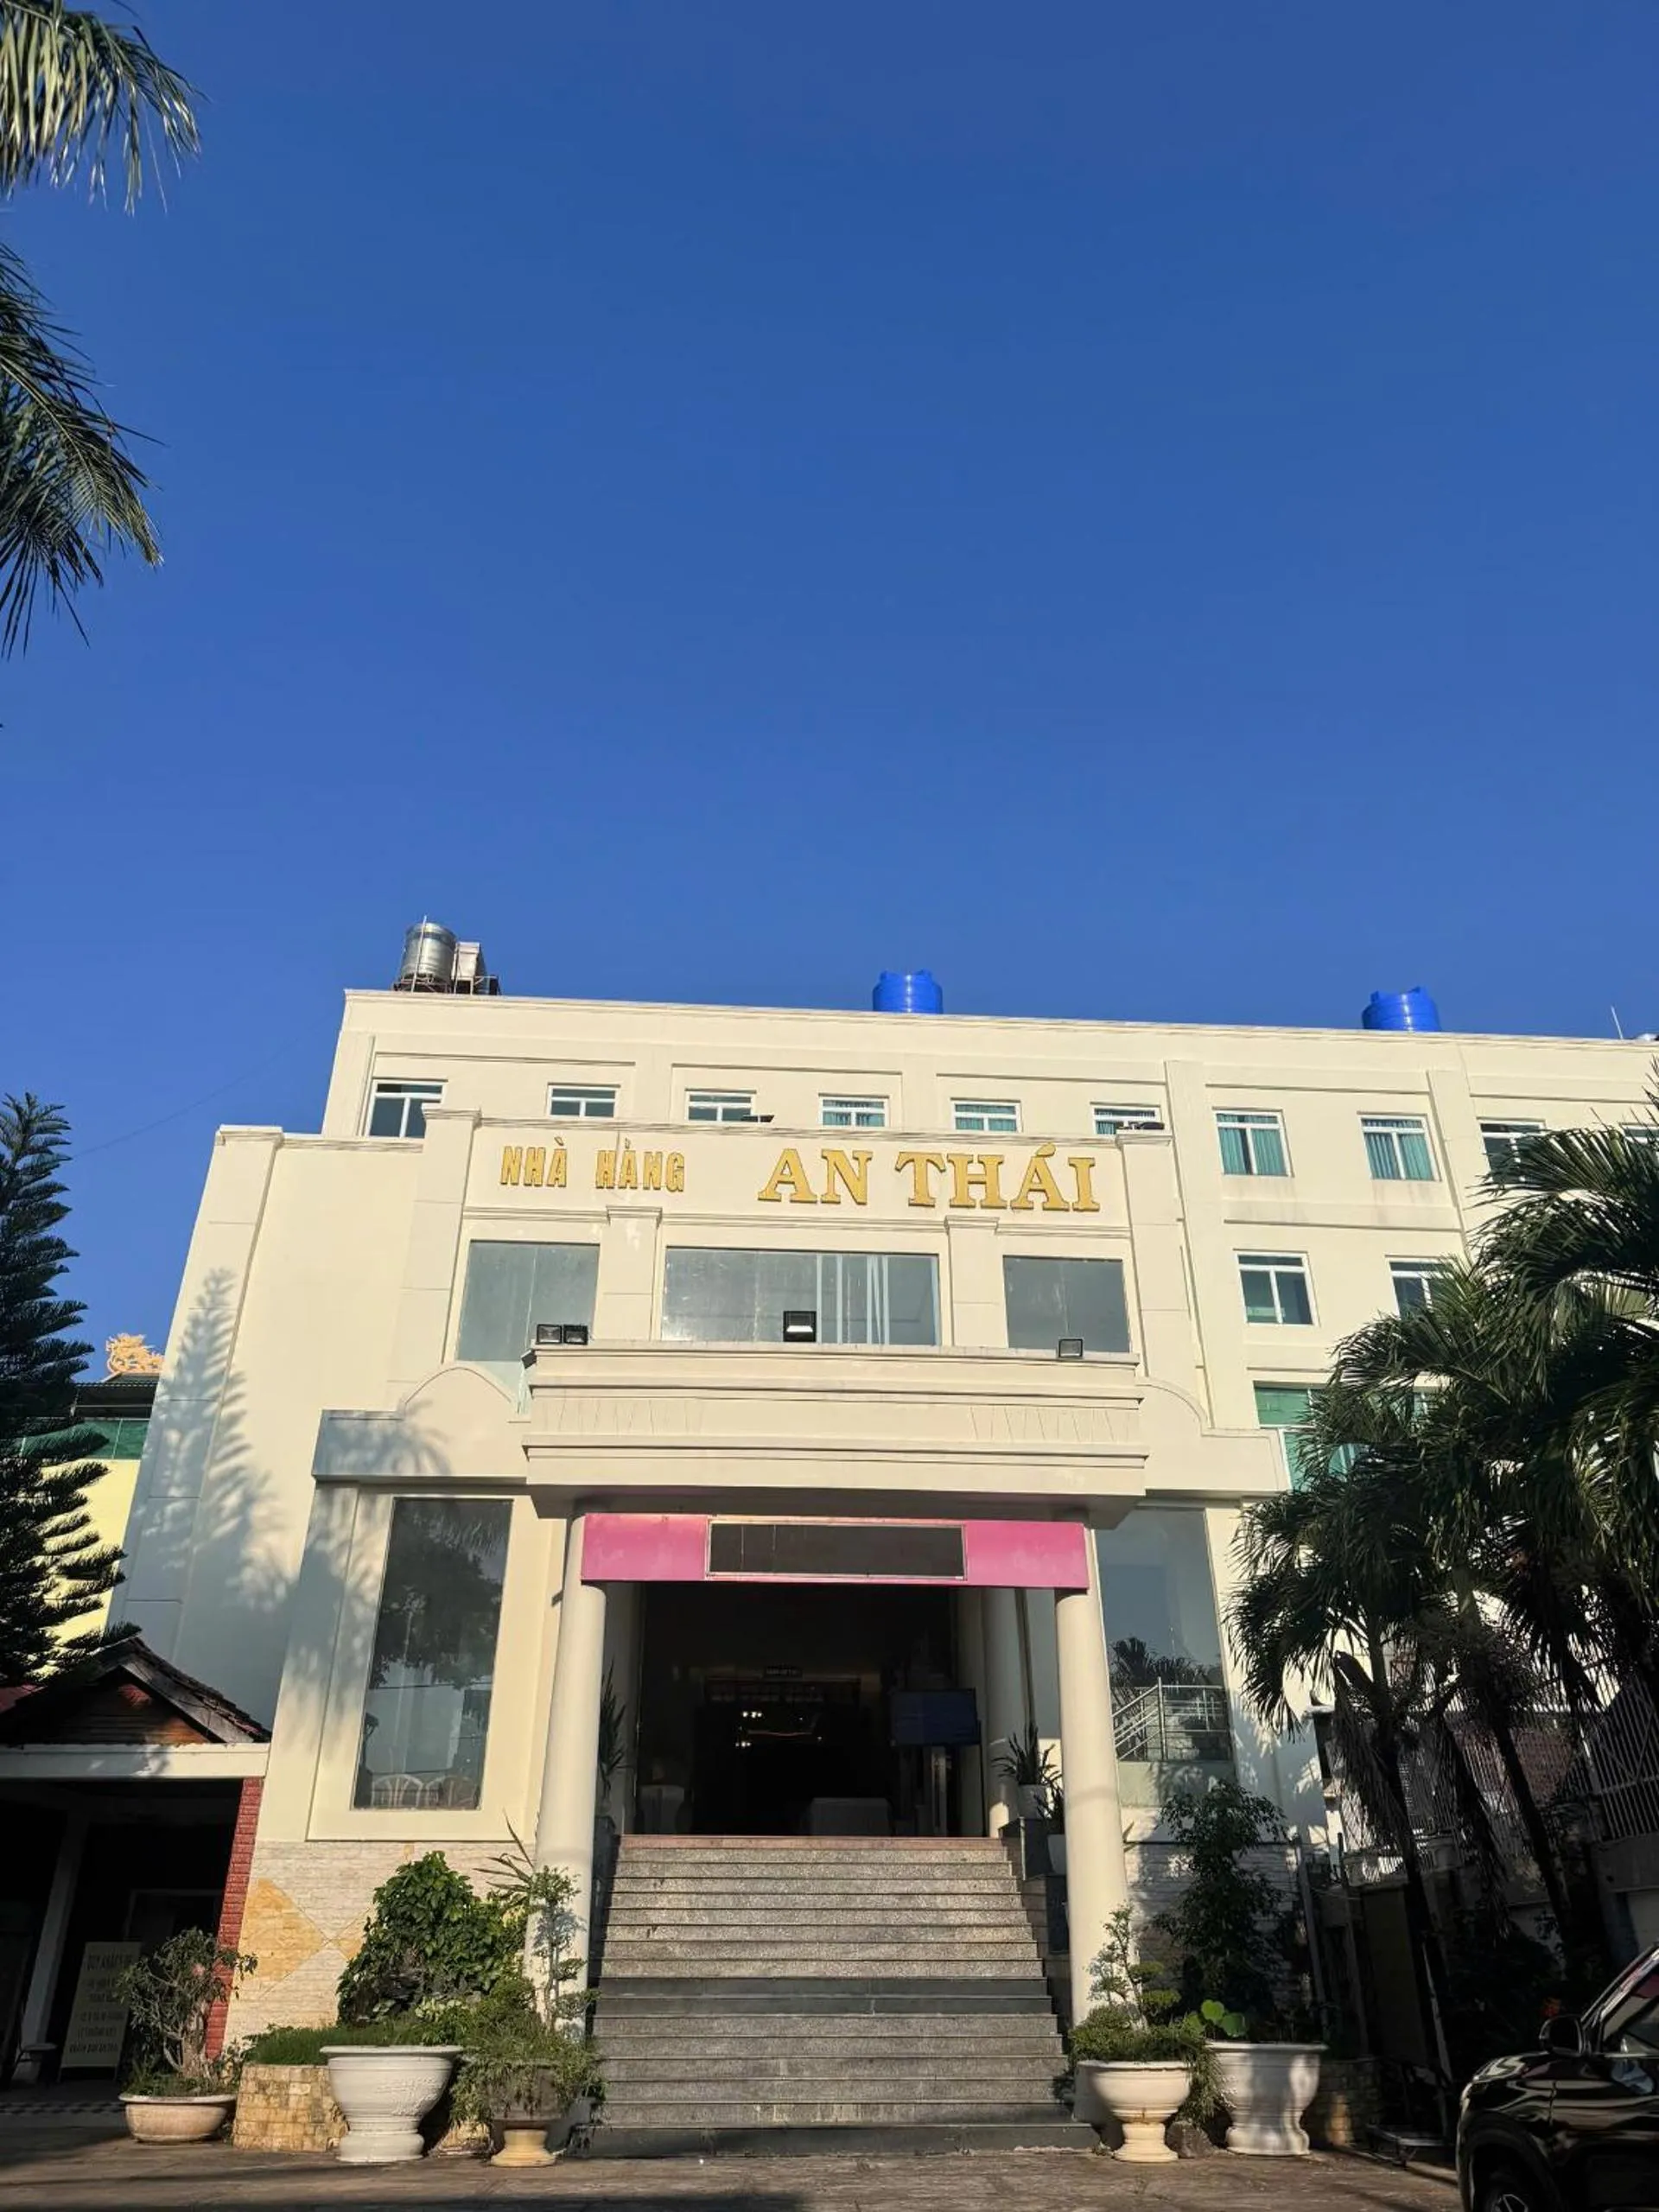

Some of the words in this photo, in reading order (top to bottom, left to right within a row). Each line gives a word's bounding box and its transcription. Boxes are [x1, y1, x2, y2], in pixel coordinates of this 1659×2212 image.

[500, 1136, 567, 1188] NHÀ
[595, 1138, 685, 1192] HÀNG
[758, 1148, 874, 1205] AN
[894, 1142, 1101, 1211] THÁI
